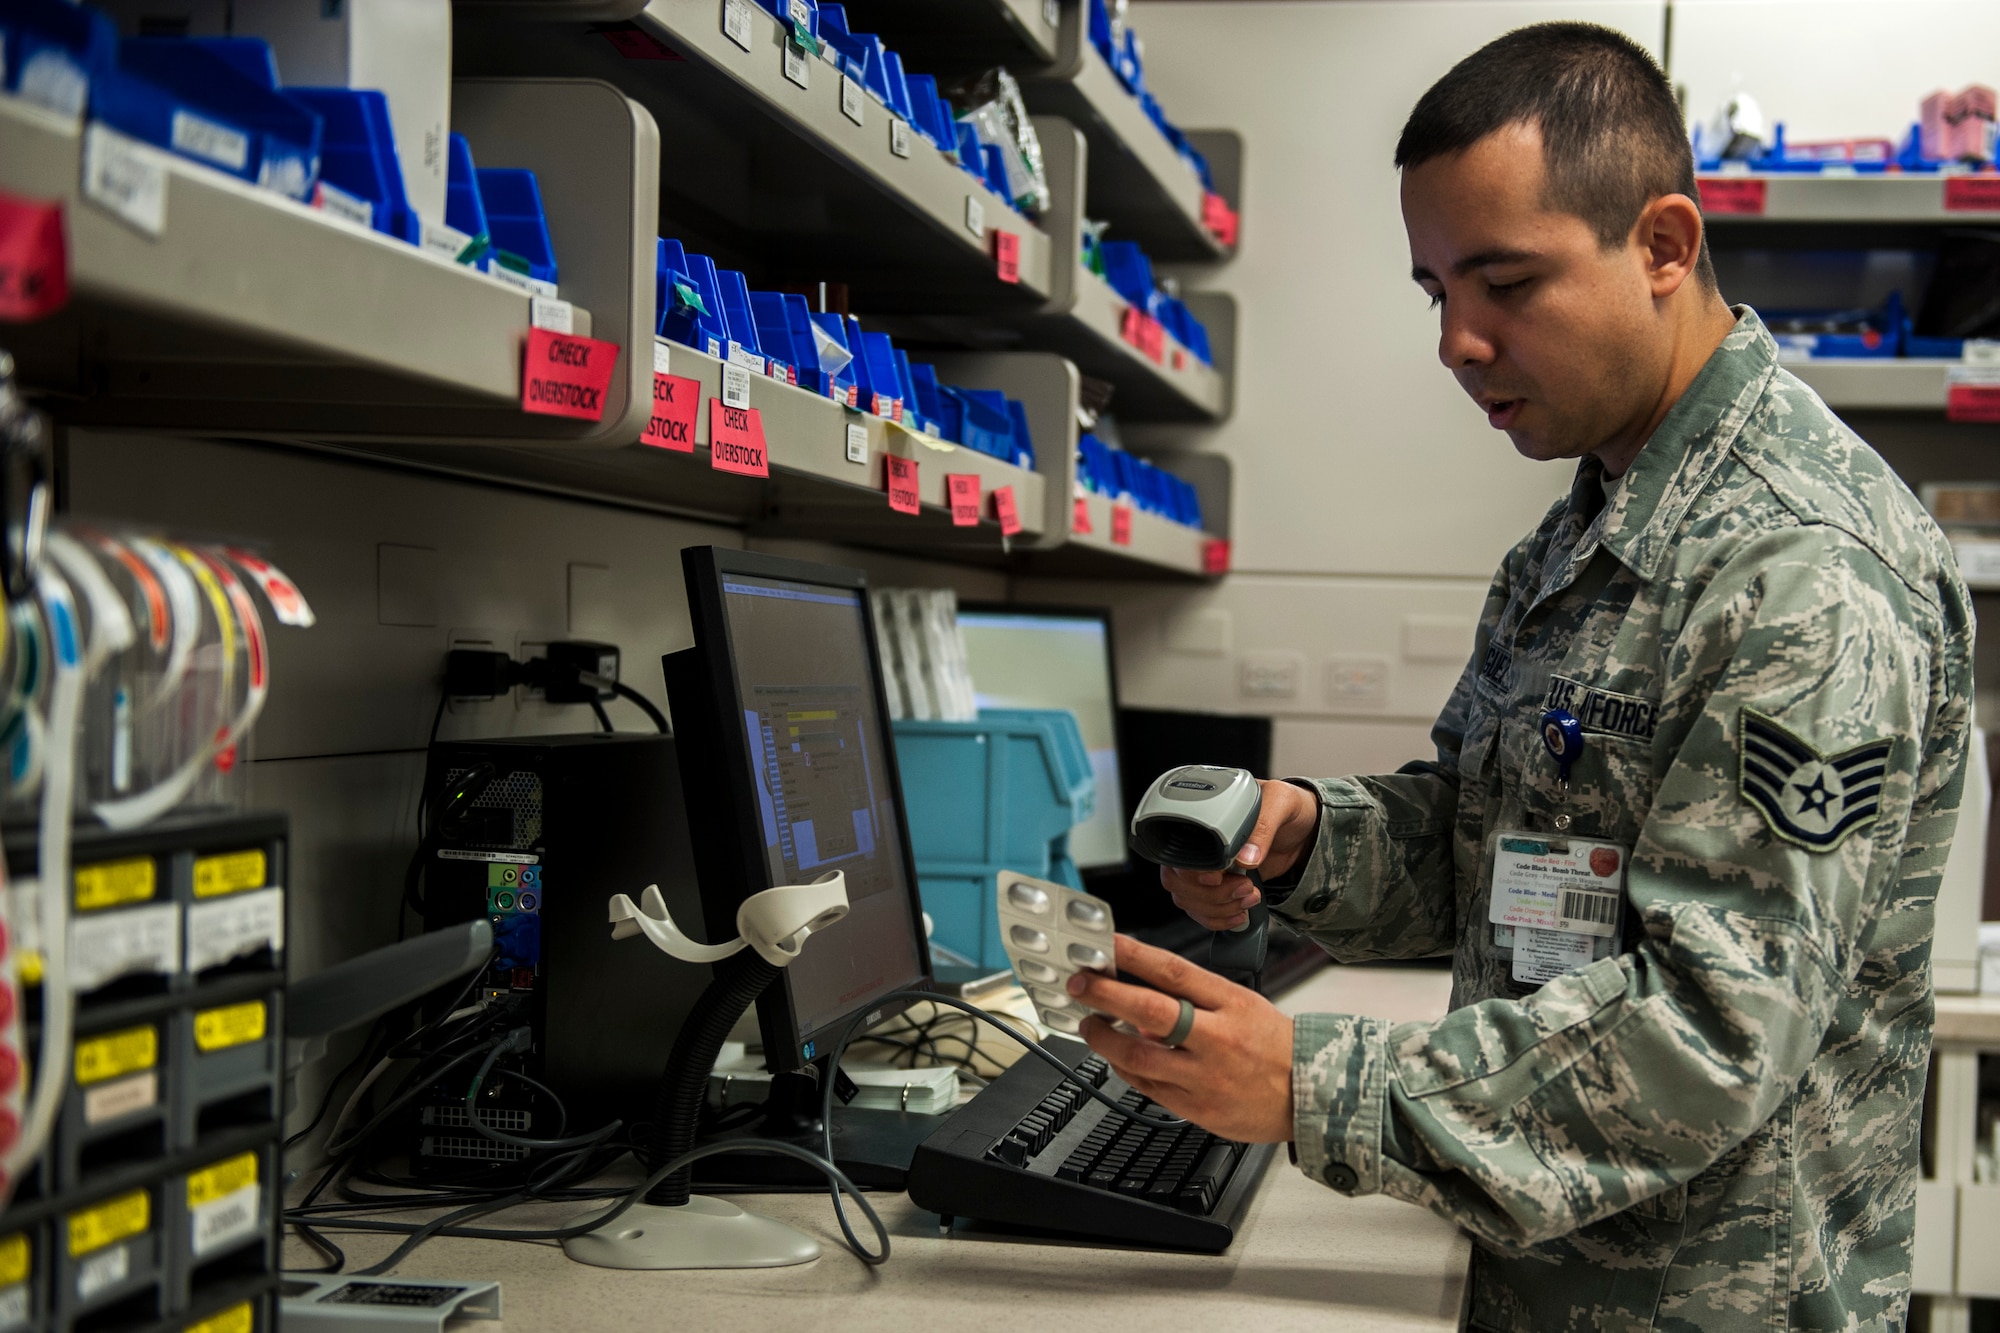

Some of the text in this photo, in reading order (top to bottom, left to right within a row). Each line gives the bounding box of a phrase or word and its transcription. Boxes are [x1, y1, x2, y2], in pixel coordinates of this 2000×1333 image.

[548, 340, 592, 368] CHECK
[530, 378, 602, 411] OVERSTOCK
[654, 379, 674, 403] ECK
[647, 416, 688, 442] STOCK
[724, 410, 748, 432] CHECK
[716, 441, 762, 467] OVERSTOCK
[1548, 679, 1575, 711] U.S
[1590, 692, 1659, 736] FORCE
